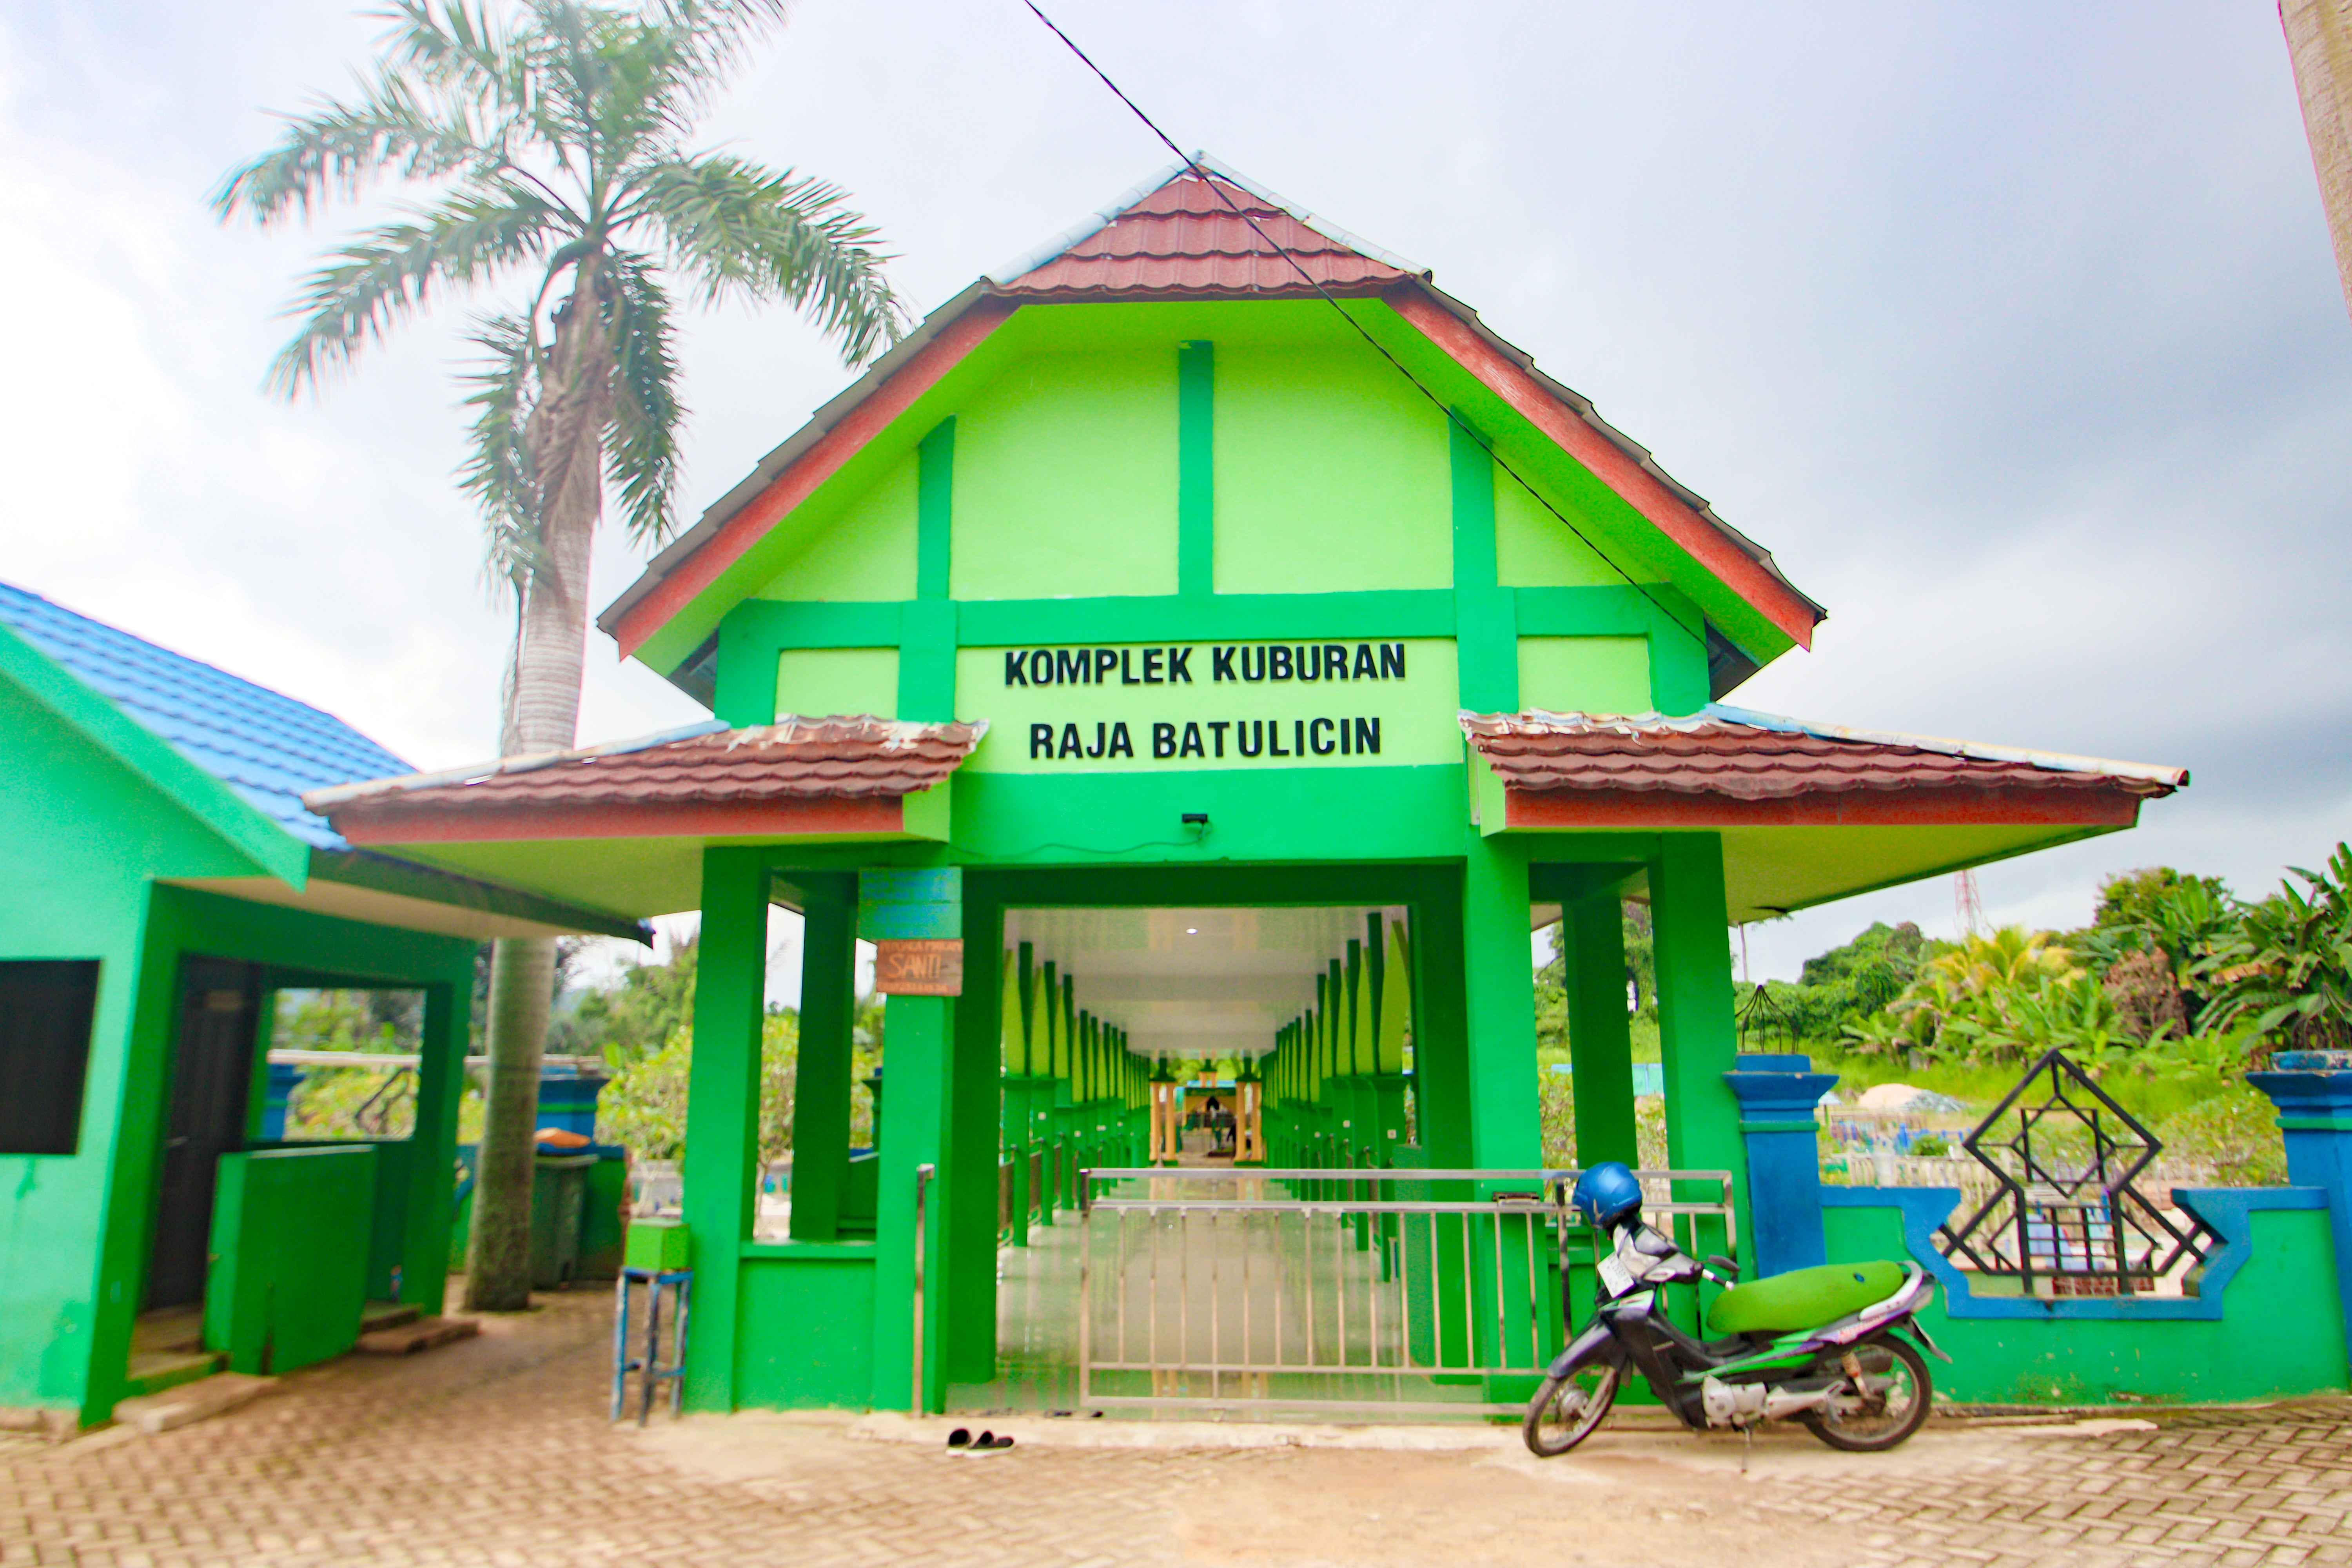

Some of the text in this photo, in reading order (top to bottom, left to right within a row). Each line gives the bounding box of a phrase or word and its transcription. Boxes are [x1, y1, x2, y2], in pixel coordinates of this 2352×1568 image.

[1005, 644, 1406, 686] KOMPLEK KUBURAN
[1030, 717, 1380, 759] RAJA BATULICIN
